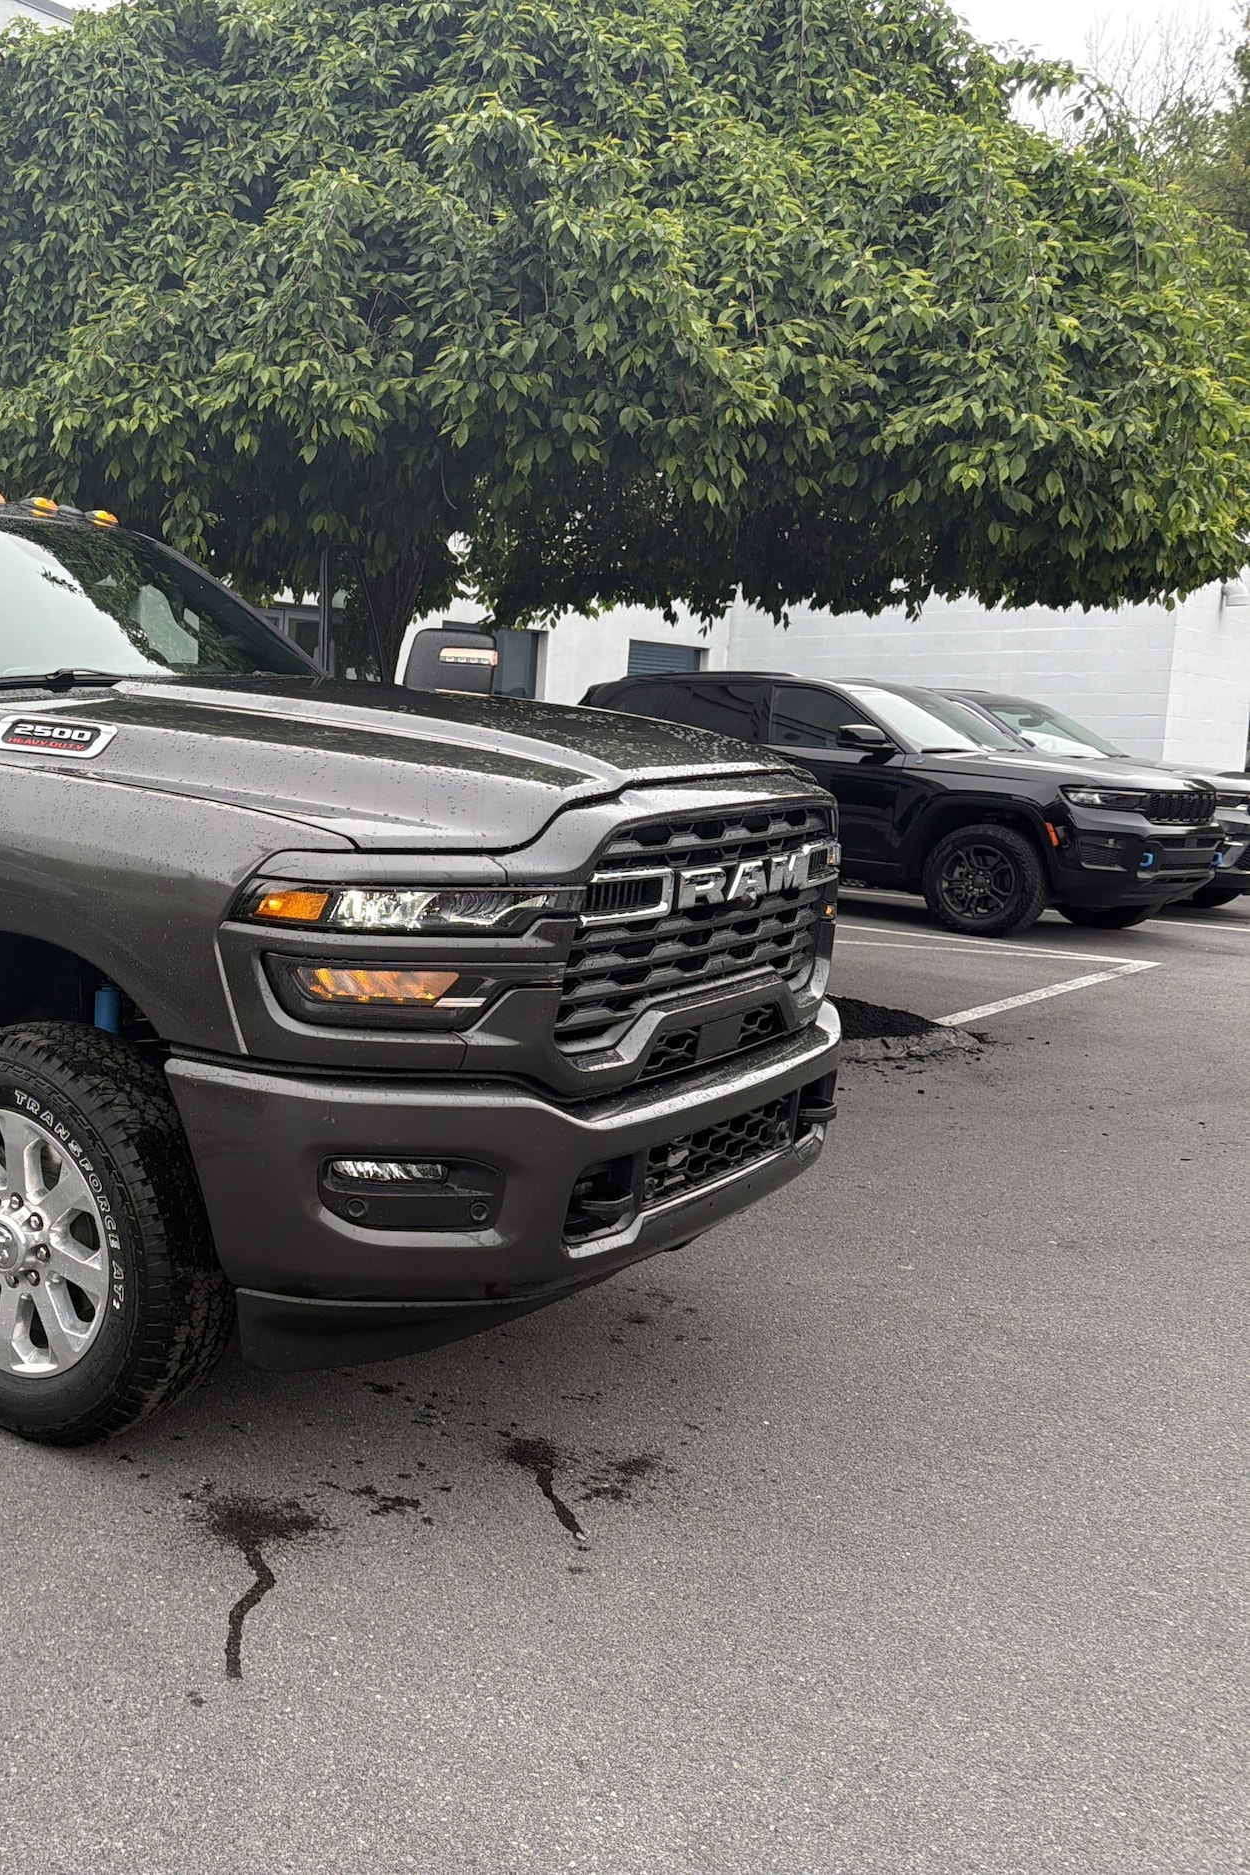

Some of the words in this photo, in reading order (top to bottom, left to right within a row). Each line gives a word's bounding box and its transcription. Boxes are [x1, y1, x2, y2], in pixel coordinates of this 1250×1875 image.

[8, 737, 46, 746] HEAVY
[49, 742, 85, 751] DUTY
[13, 724, 92, 742] 2500
[678, 853, 809, 909] RAM
[14, 1089, 121, 1250] TRANSFORCE
